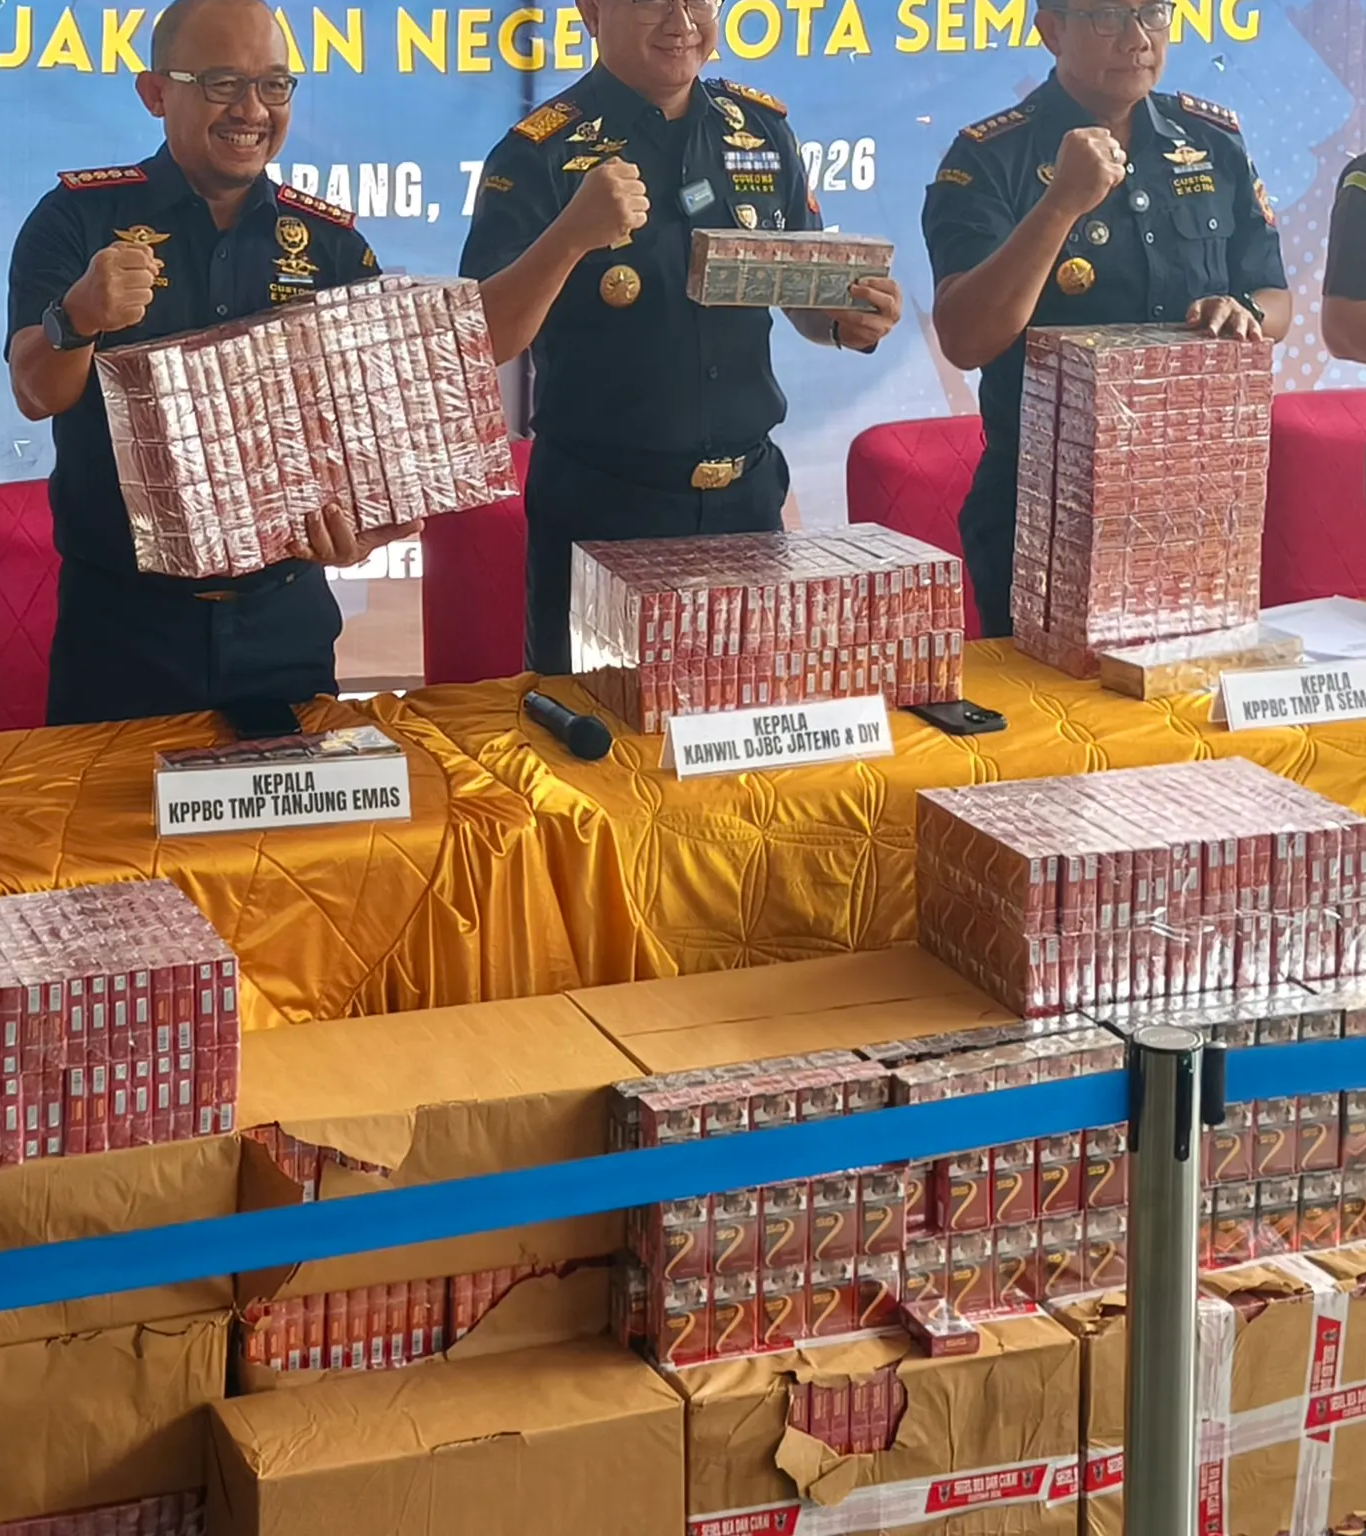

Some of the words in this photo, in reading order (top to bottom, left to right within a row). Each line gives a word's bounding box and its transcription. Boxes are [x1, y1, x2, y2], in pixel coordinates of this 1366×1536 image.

[397, 7, 599, 73] NEGE
[799, 137, 877, 191] 026
[1300, 671, 1352, 695] KEPALA
[1242, 697, 1289, 721] KPPBC
[1289, 694, 1320, 716] TMP
[1325, 692, 1335, 713] A
[752, 711, 808, 736] KEPALA
[683, 740, 741, 765] KANWIL
[744, 734, 784, 759] DJBC
[787, 727, 841, 754] JATENG
[844, 727, 855, 745] &
[857, 721, 881, 744] DIY
[252, 770, 316, 796] KEPALA
[168, 799, 224, 824] KPPBC
[228, 796, 266, 819] TMP
[271, 788, 348, 816] TANJUNG
[352, 786, 401, 811] EMAS
